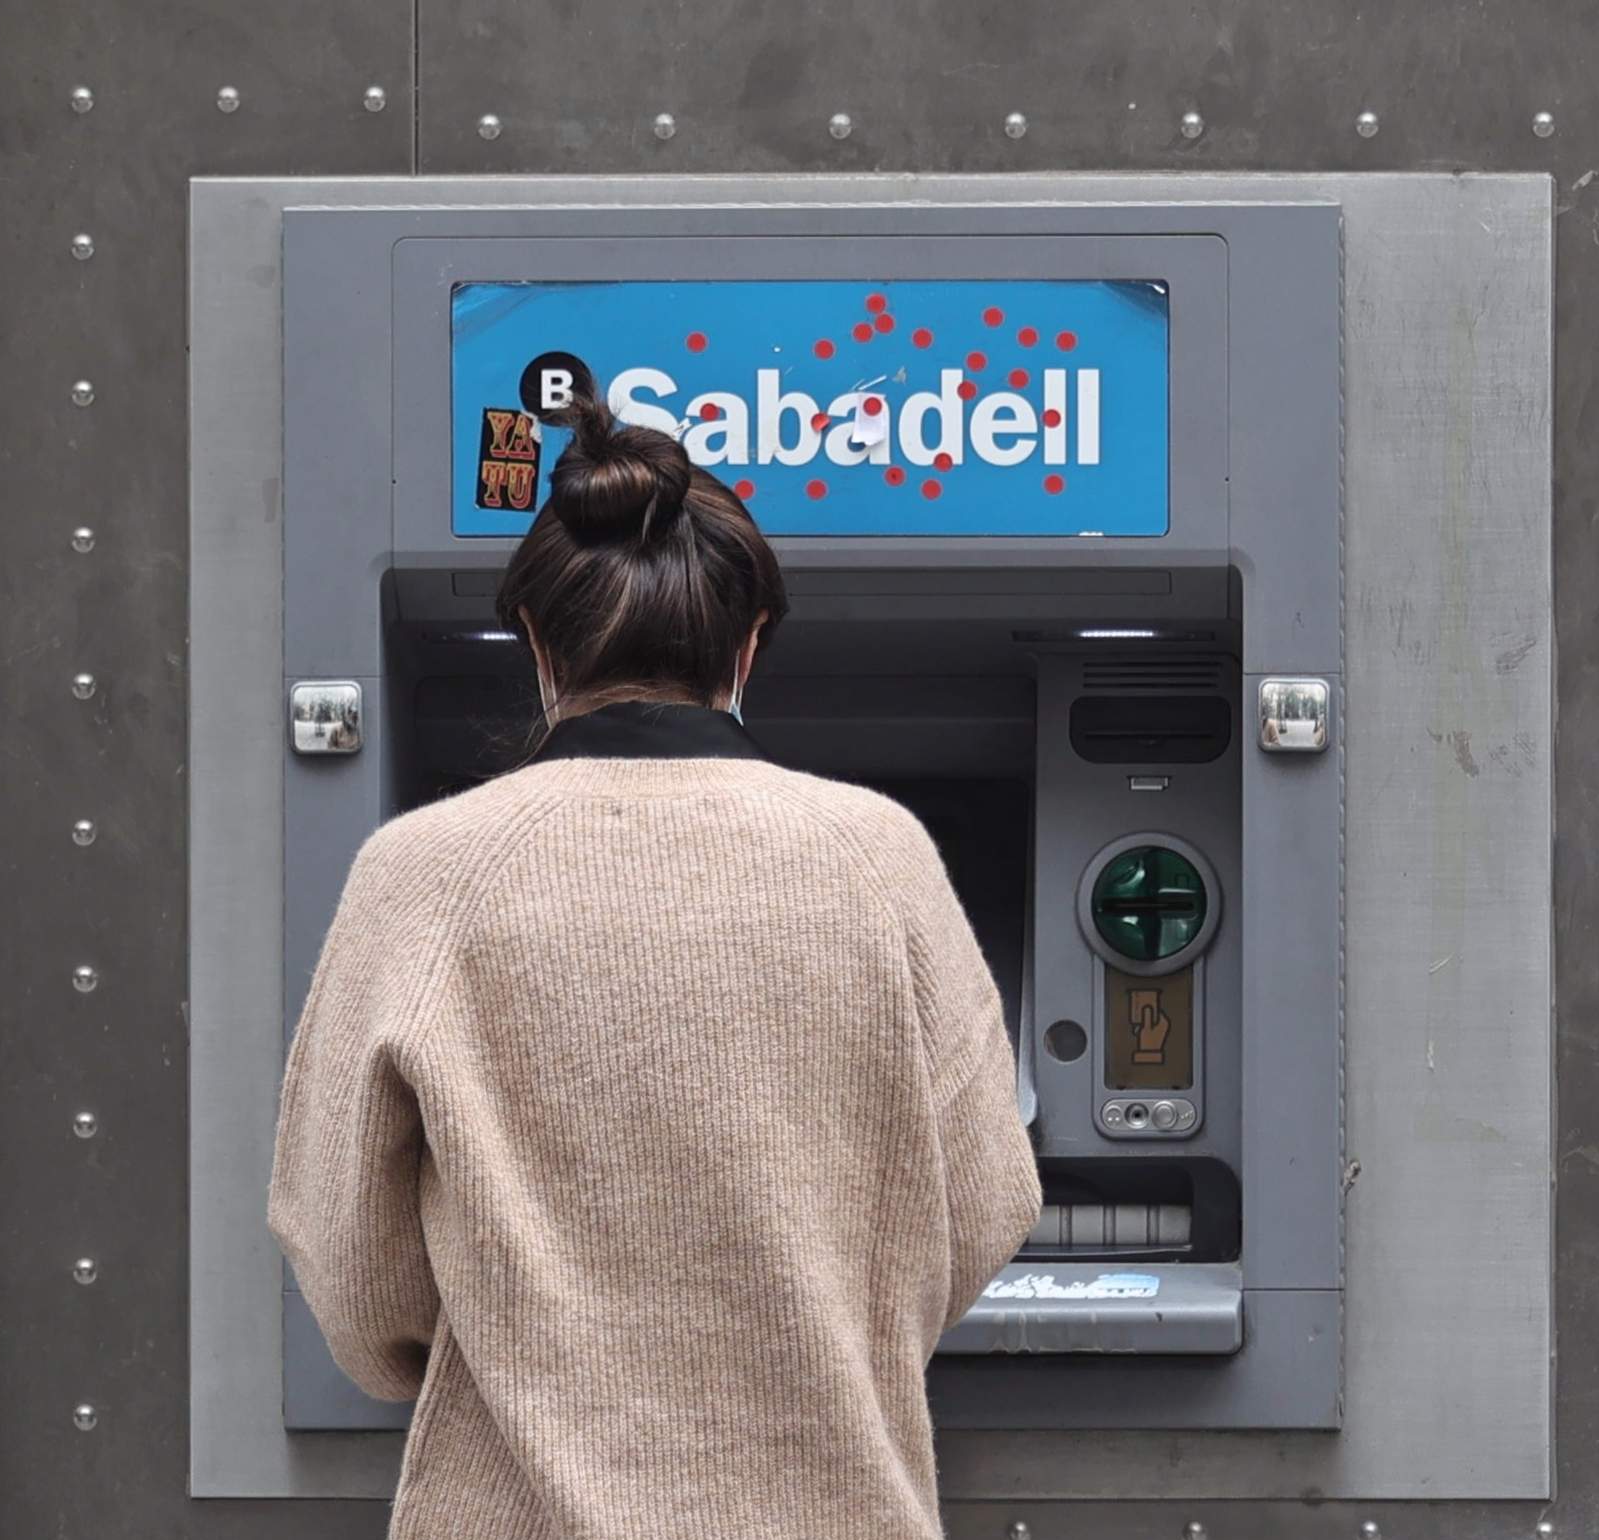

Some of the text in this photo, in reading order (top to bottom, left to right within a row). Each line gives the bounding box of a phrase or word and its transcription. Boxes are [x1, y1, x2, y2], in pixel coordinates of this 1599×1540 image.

[487, 411, 536, 460] YA
[541, 367, 1100, 467] B Sabadell
[482, 461, 536, 509] TU
